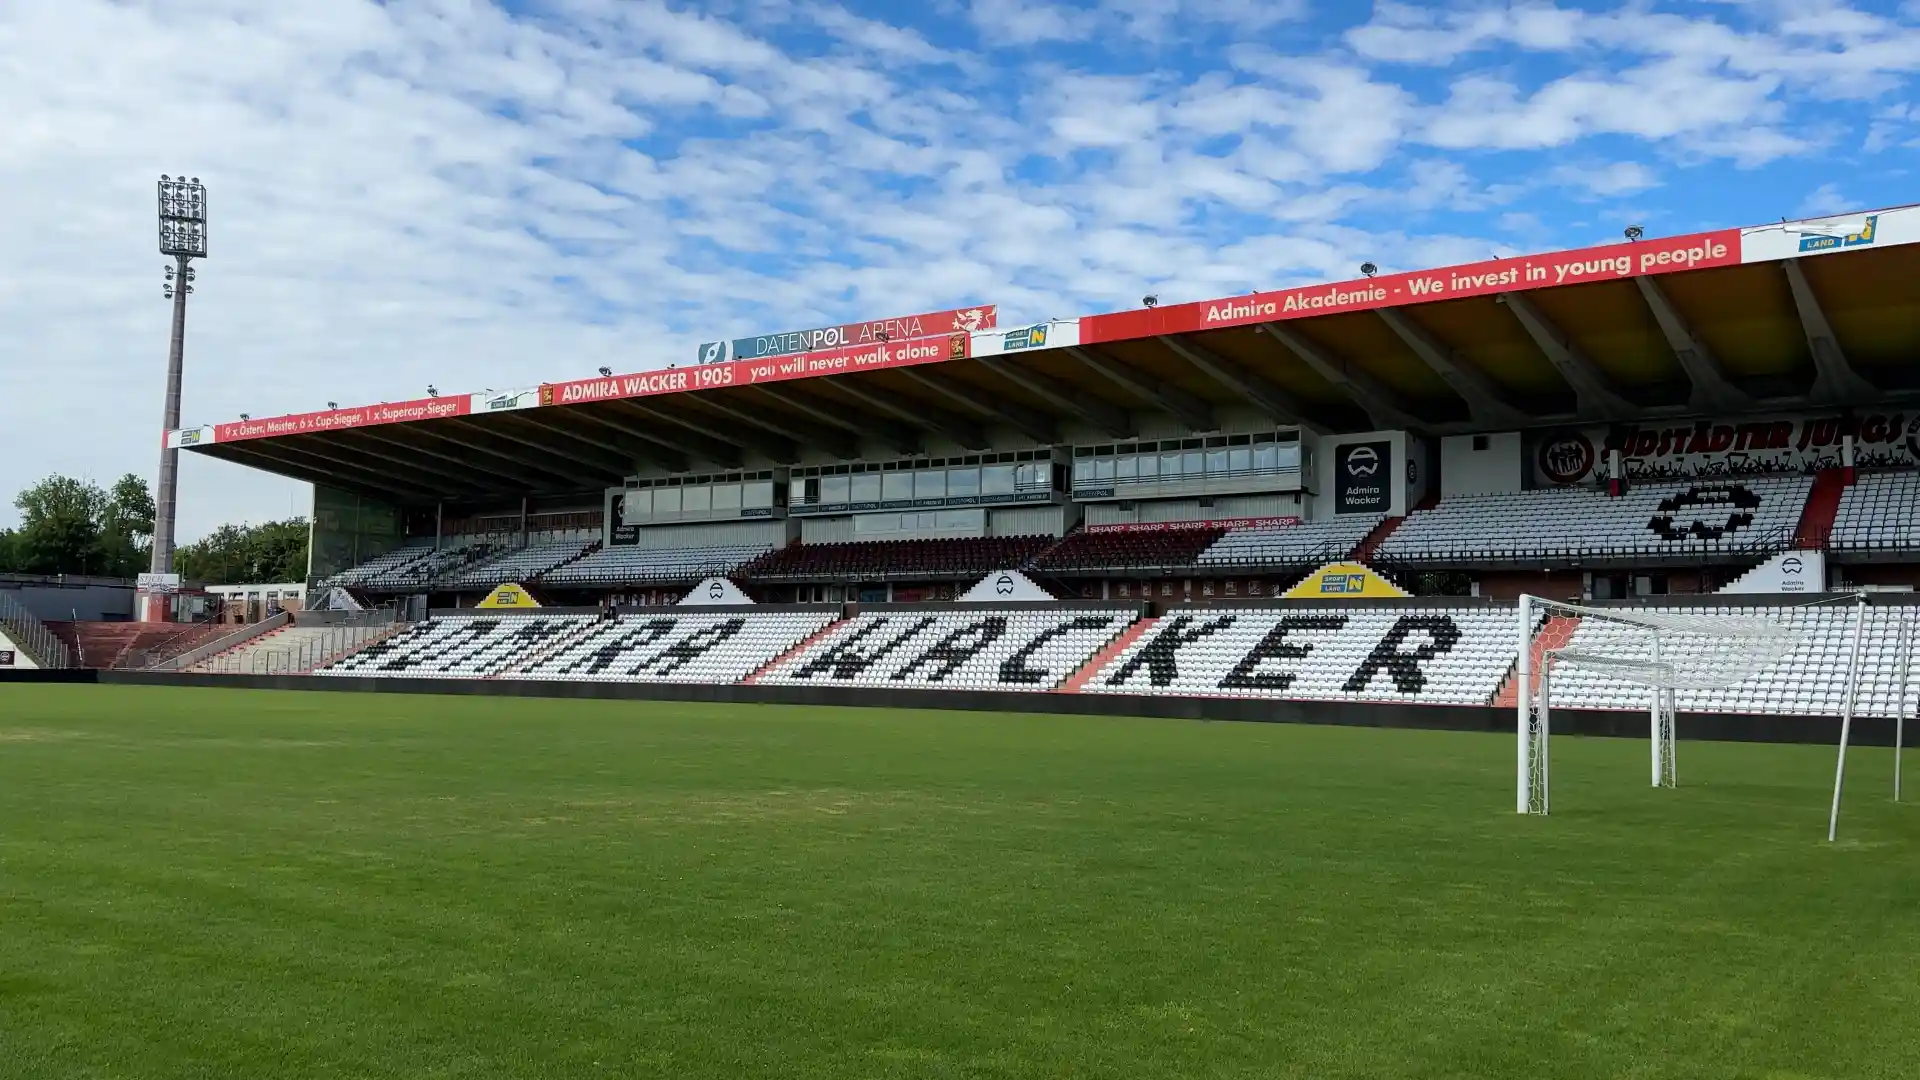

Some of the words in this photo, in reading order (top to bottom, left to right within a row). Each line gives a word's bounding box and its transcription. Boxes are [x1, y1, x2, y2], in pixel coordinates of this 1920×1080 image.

[1806, 238, 1835, 248] LAND
[1207, 300, 1276, 322] Admira
[1282, 284, 1386, 312] Akademie
[1408, 276, 1444, 296] We
[1451, 266, 1518, 291] invest
[1525, 263, 1546, 281] in
[1554, 255, 1631, 283] young
[1640, 239, 1727, 272] people
[756, 328, 849, 355] DATENPOL
[859, 317, 923, 343] ARENA
[562, 381, 619, 402] ADMIRA
[624, 373, 687, 395] WACKER
[693, 366, 733, 387] 1905
[750, 365, 775, 383] you
[780, 357, 805, 375] will
[809, 355, 849, 371] never
[854, 345, 890, 365] walk
[896, 342, 939, 360] alone
[225, 428, 230, 438] 9
[232, 429, 238, 437] x
[267, 420, 298, 433] Meister,
[300, 418, 305, 429] 6
[307, 420, 314, 428] x
[316, 413, 363, 428] Cup-Sieger,
[382, 402, 457, 421] Supercup-Sieger
[1345, 496, 1381, 505] Wacker
[1346, 486, 1380, 495] Admira
[1090, 525, 1124, 534] SHARP
[1129, 523, 1164, 532] SHARP
[1169, 521, 1206, 530] SHARP
[1212, 519, 1250, 528] SHARP
[1255, 518, 1295, 527] SHARP
[791, 614, 1463, 692] WACKER
